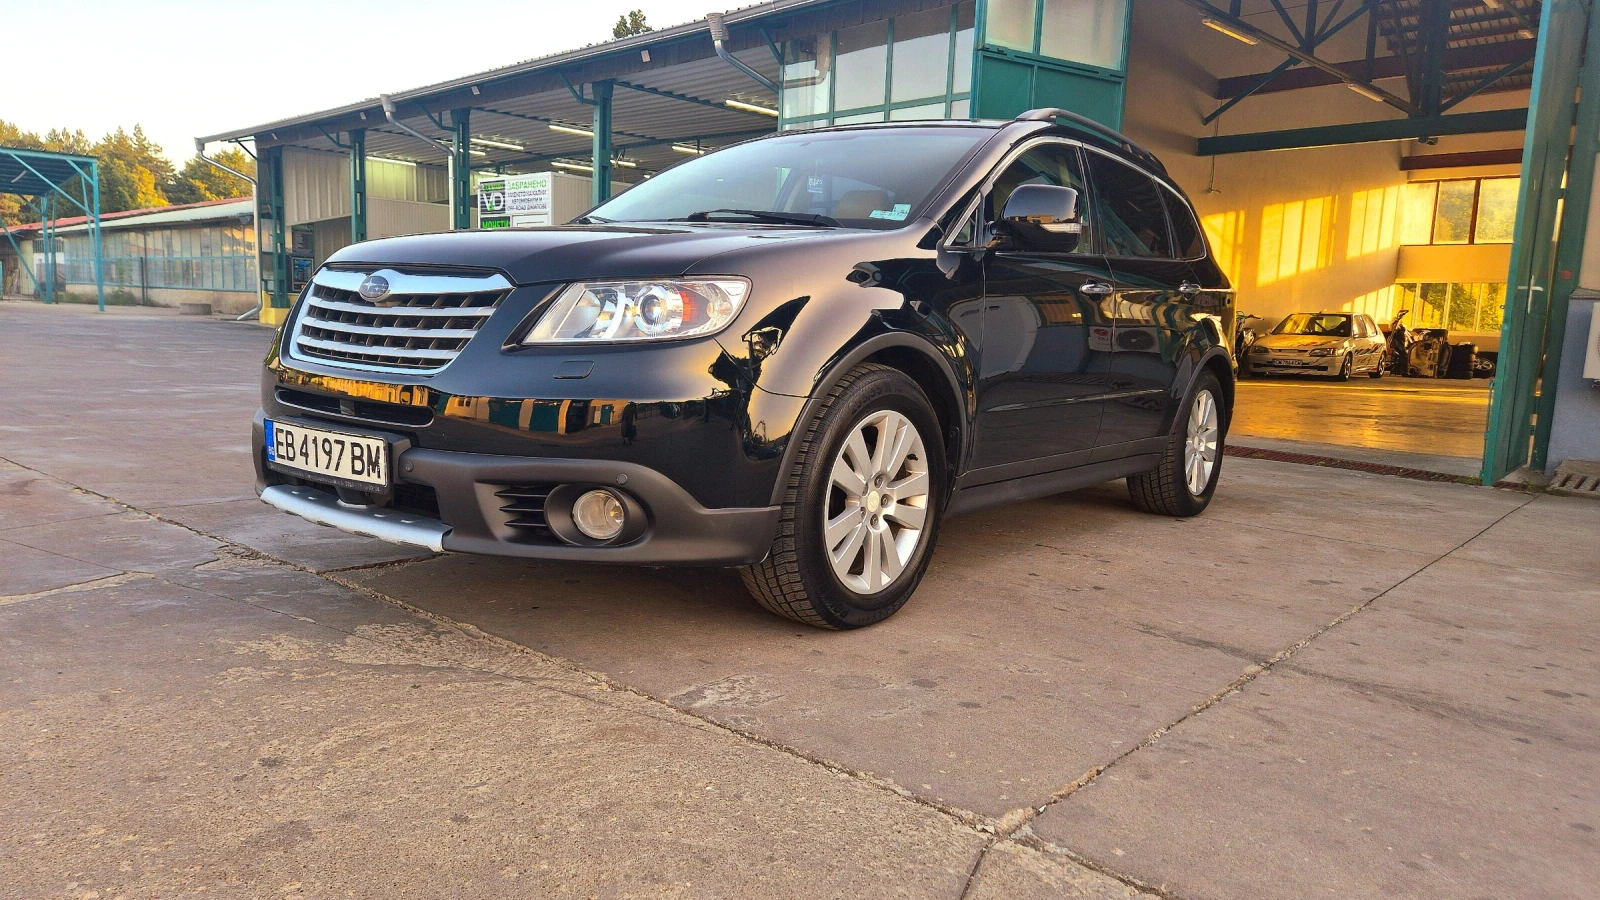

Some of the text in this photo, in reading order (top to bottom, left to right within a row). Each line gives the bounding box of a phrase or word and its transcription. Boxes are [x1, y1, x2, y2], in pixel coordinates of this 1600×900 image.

[507, 179, 547, 190] ЗАБРАНЕНО
[275, 427, 296, 462] EB
[300, 433, 346, 472] 4197
[350, 441, 381, 479] BM
